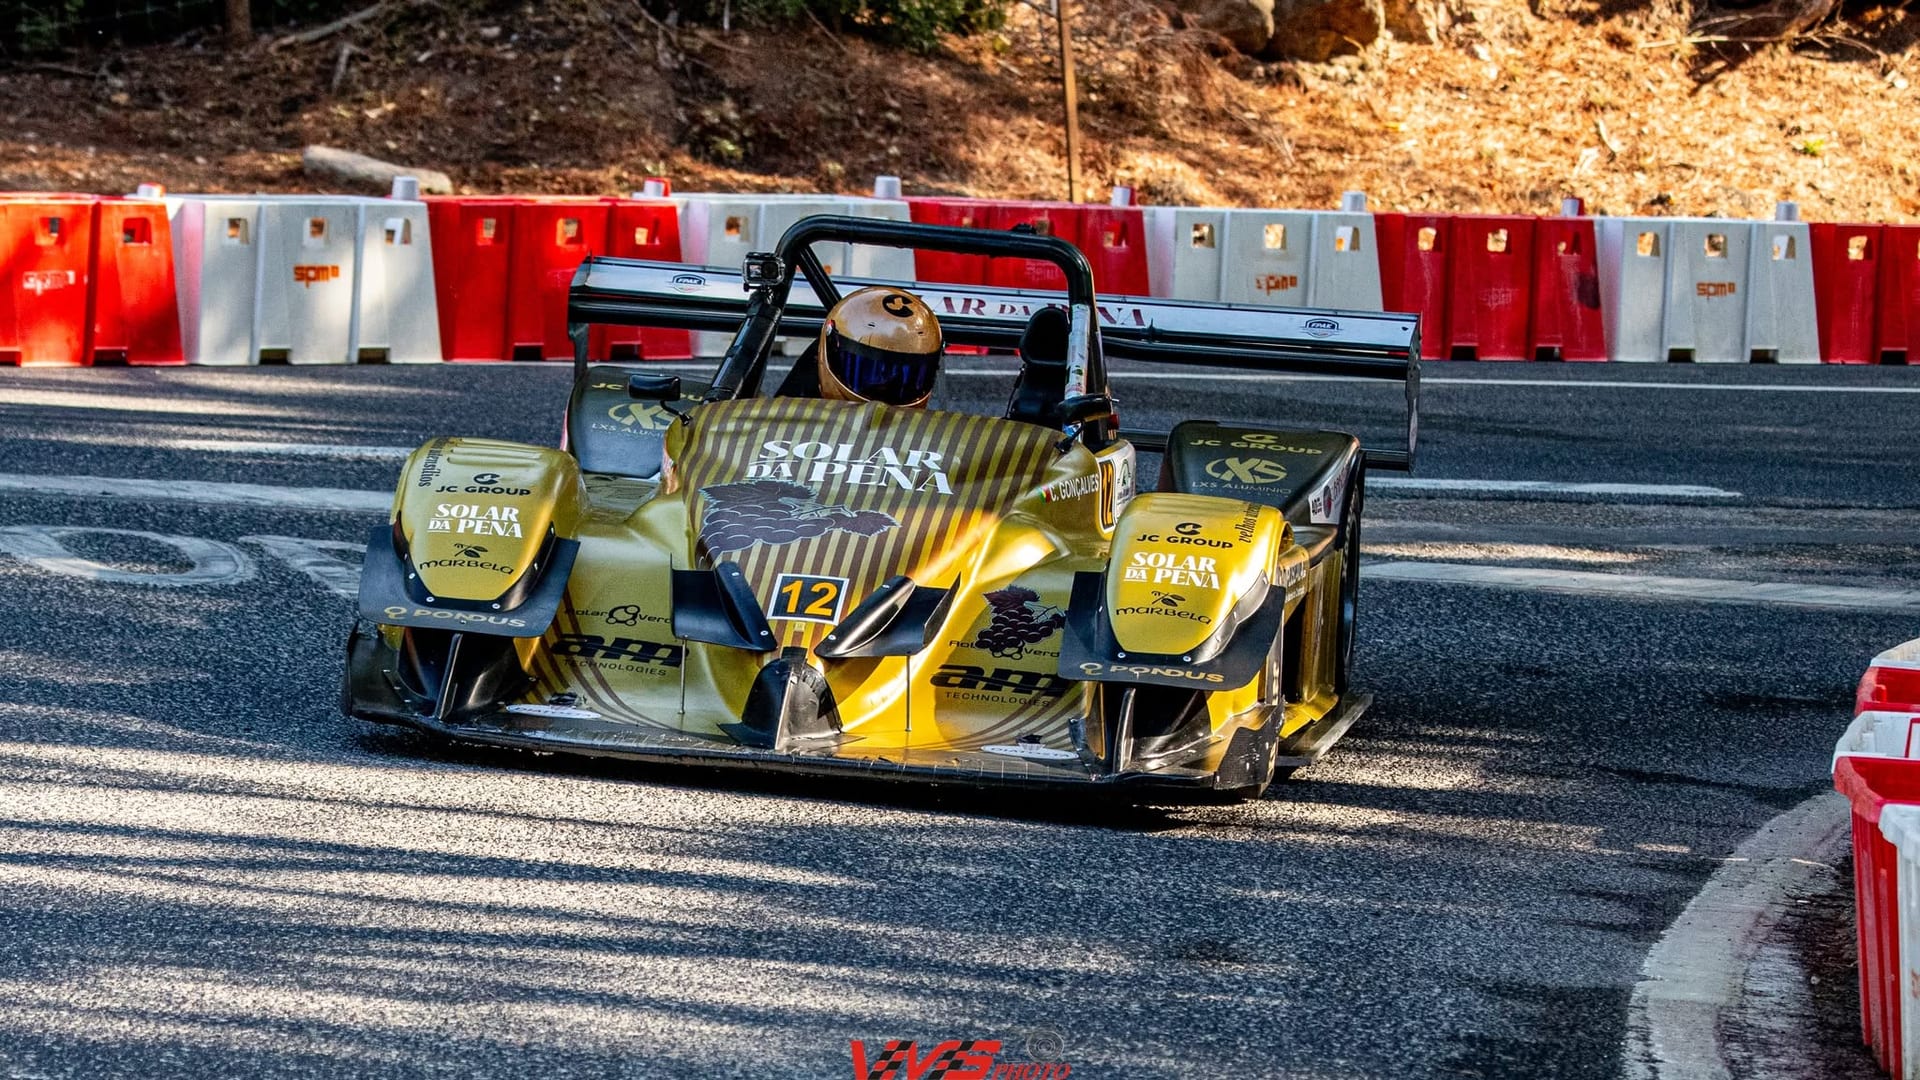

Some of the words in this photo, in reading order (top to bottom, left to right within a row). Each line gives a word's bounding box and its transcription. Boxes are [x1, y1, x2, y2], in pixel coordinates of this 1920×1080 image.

[758, 440, 943, 470] SOLAR
[1230, 441, 1322, 455] GROUP
[745, 461, 793, 478] DA
[808, 461, 954, 495] PENA
[1060, 473, 1100, 500] GONÇALVES
[435, 485, 458, 493] JC
[464, 486, 531, 496] GROUP
[435, 503, 519, 522] SOLAR
[427, 520, 451, 530] DA
[456, 519, 523, 538] PENA
[1136, 534, 1160, 542] JC
[1166, 536, 1233, 549] GROUP
[1131, 551, 1216, 573] SOLAR
[1123, 568, 1148, 580] DA
[1153, 568, 1220, 590] PENA
[781, 580, 838, 617] 12
[413, 608, 526, 628] PONDUS
[564, 659, 667, 677] TECHNOLOGIES
[1109, 664, 1225, 684] PONDUS
[944, 690, 1051, 708] TECHNOLOGIES
